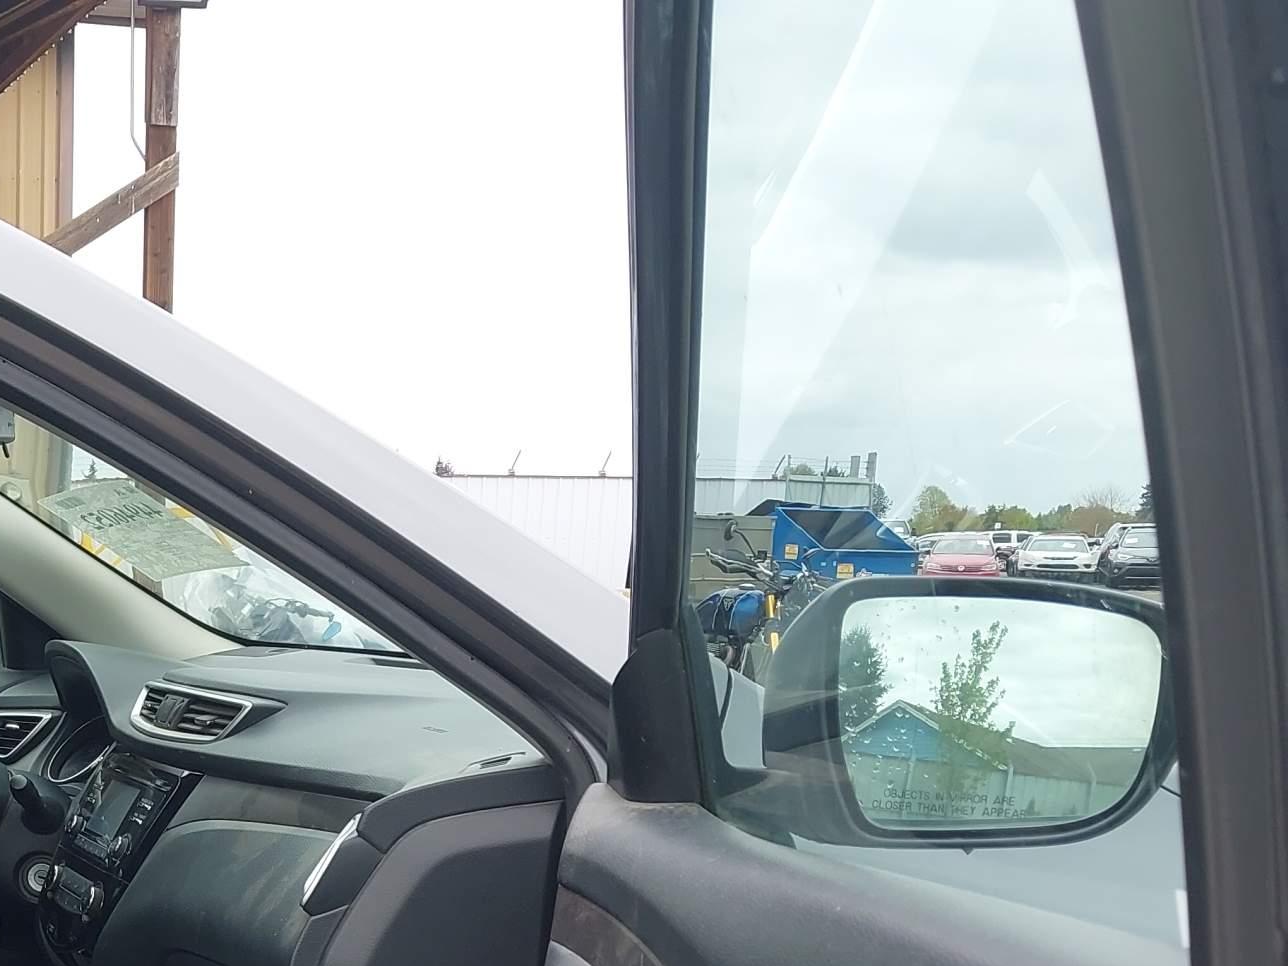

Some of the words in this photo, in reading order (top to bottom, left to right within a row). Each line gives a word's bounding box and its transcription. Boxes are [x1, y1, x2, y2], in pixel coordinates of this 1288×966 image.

[884, 788, 930, 800] OBJECTS
[936, 791, 945, 801] IN
[992, 796, 1016, 807] ARE
[872, 800, 912, 811] CLOSER
[918, 802, 945, 814] THAN
[982, 807, 1026, 819] APPEAR
